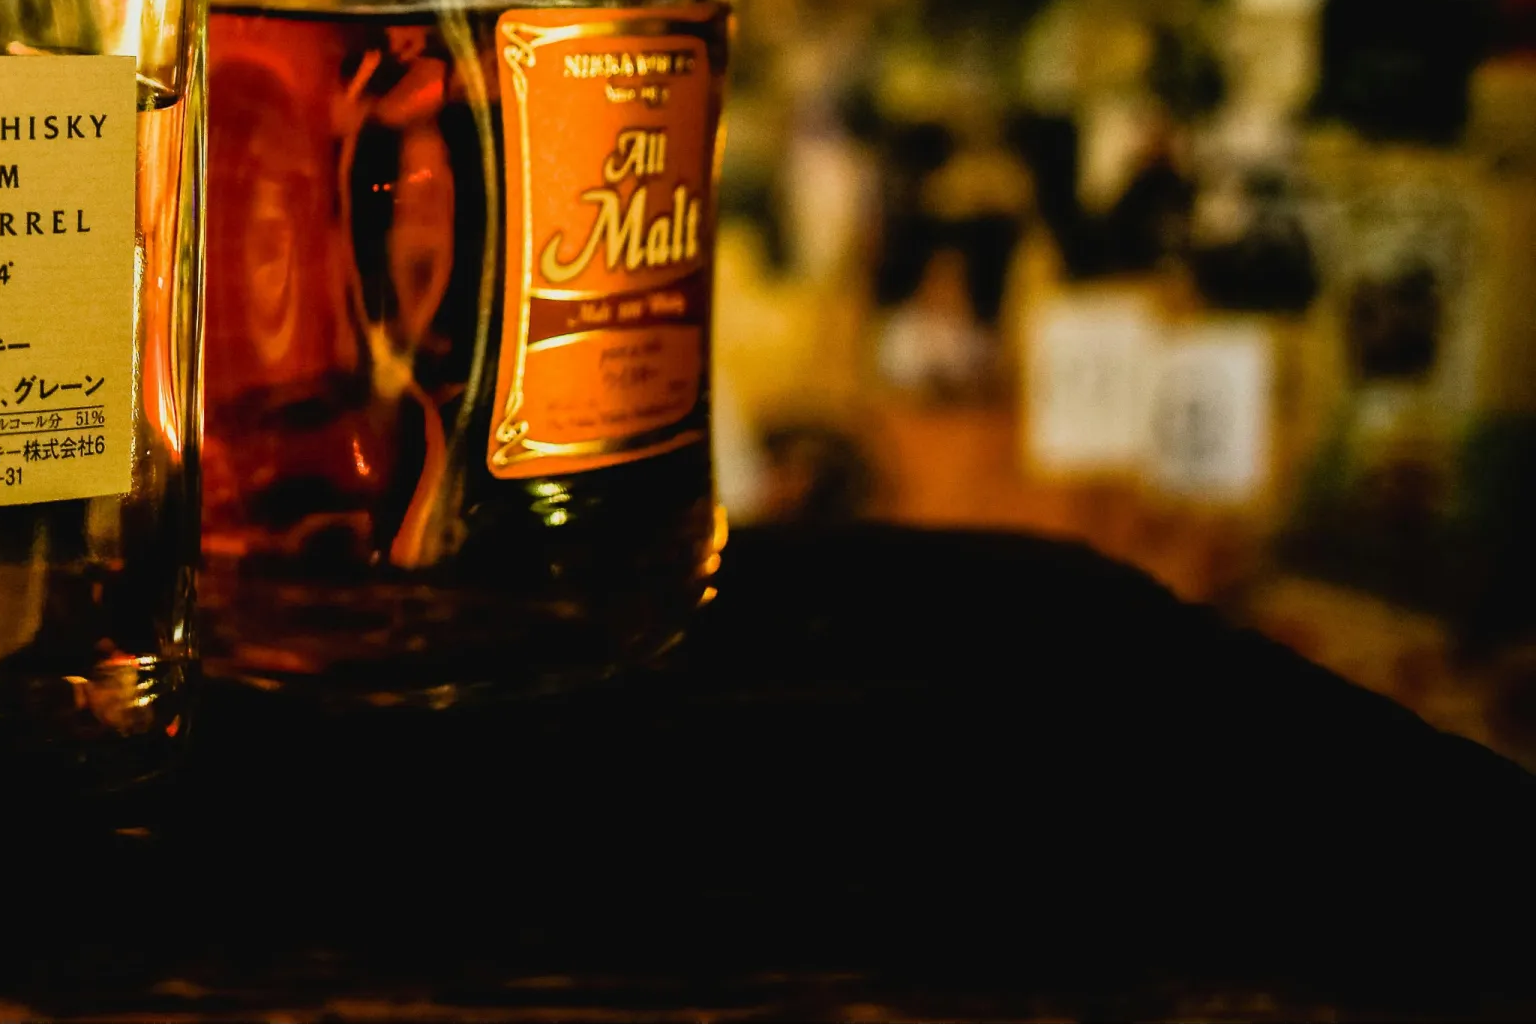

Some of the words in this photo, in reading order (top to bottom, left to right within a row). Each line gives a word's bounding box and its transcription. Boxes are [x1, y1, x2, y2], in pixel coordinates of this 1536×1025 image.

[605, 129, 667, 182] All
[540, 185, 701, 283] Malt
[76, 410, 105, 426] 51%
